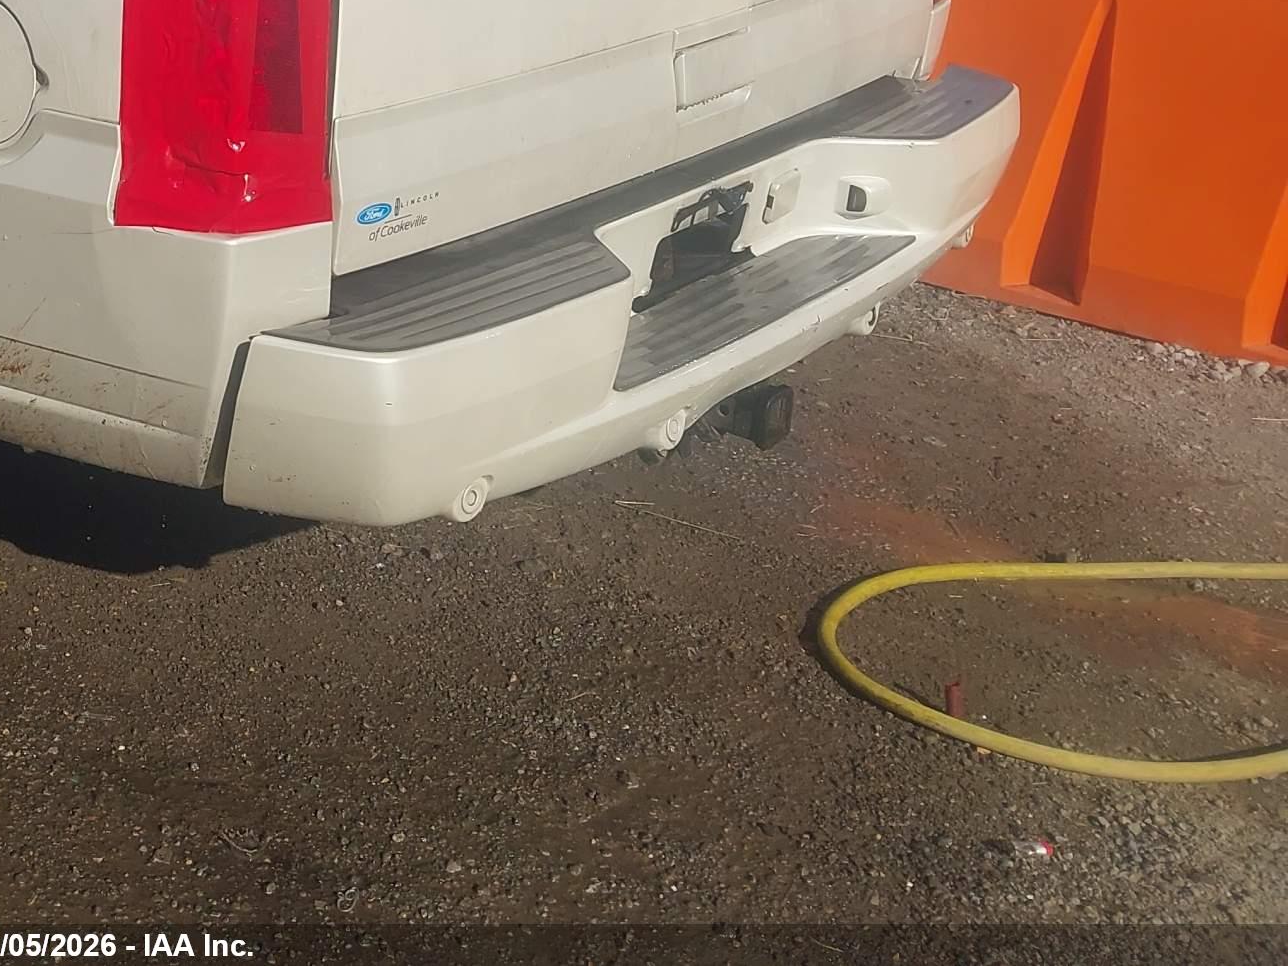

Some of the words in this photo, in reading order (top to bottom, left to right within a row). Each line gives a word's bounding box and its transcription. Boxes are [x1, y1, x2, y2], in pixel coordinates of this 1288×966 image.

[400, 192, 440, 209] LINCOLN
[368, 226, 381, 242] of
[380, 214, 428, 238] Cookeville
